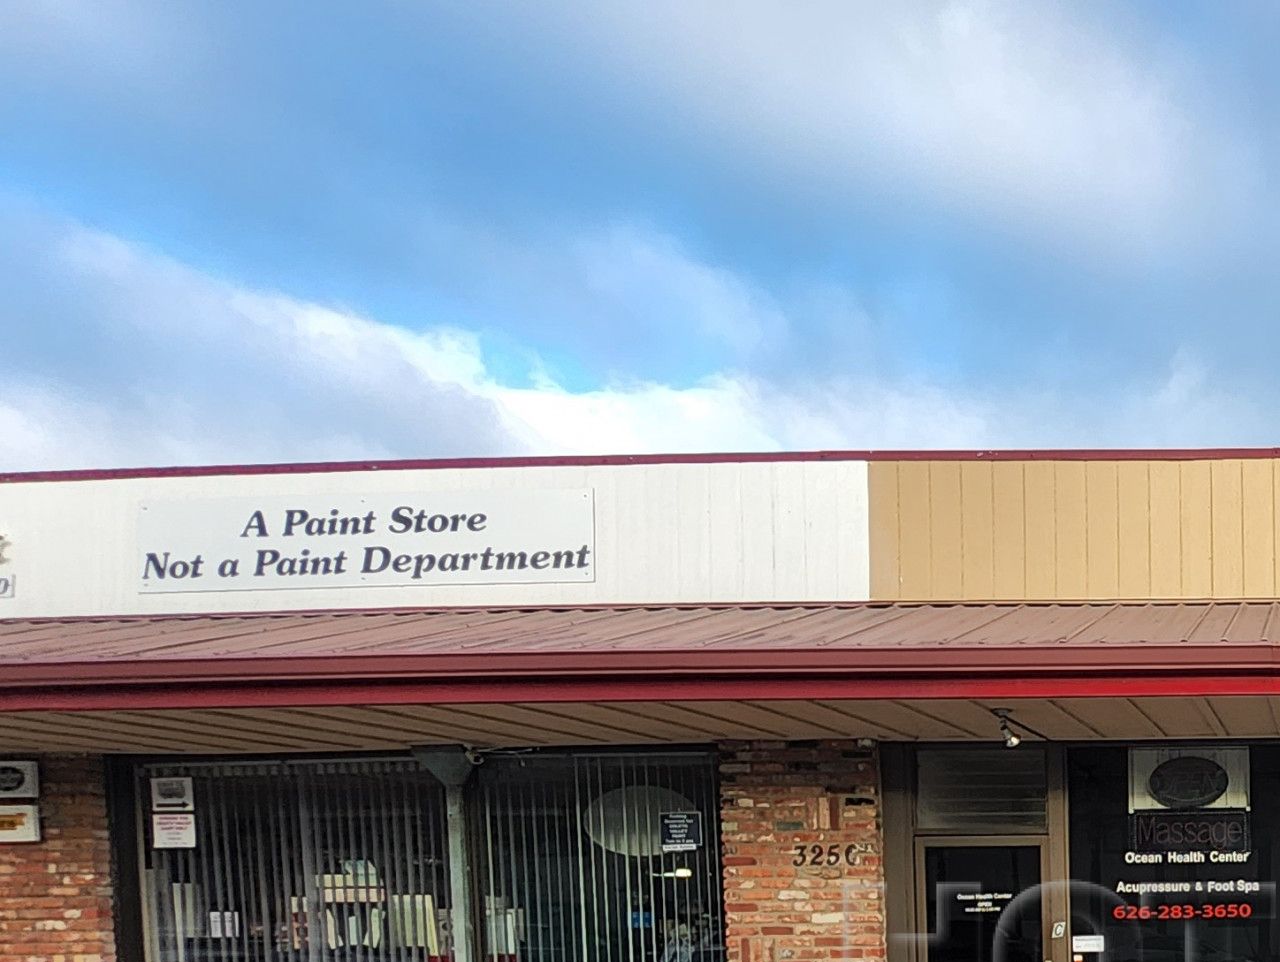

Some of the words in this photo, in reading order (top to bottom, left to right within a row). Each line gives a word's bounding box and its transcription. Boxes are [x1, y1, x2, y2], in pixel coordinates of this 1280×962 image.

[241, 509, 269, 538] A
[282, 508, 376, 537] Paint
[388, 506, 488, 534] Store
[142, 552, 204, 580] Not
[217, 558, 240, 578] a
[253, 548, 348, 577] Paint
[360, 544, 592, 580] Department
[1137, 815, 1243, 849] Massage
[1124, 851, 1163, 864] Ocean
[1167, 851, 1205, 863] Health
[1209, 850, 1251, 863] Center
[1116, 880, 1191, 895] Acupressure
[1194, 881, 1203, 892] &
[1207, 879, 1235, 893] Foot
[1236, 879, 1260, 894] Spa
[1112, 903, 1252, 920] 626-283-3650
